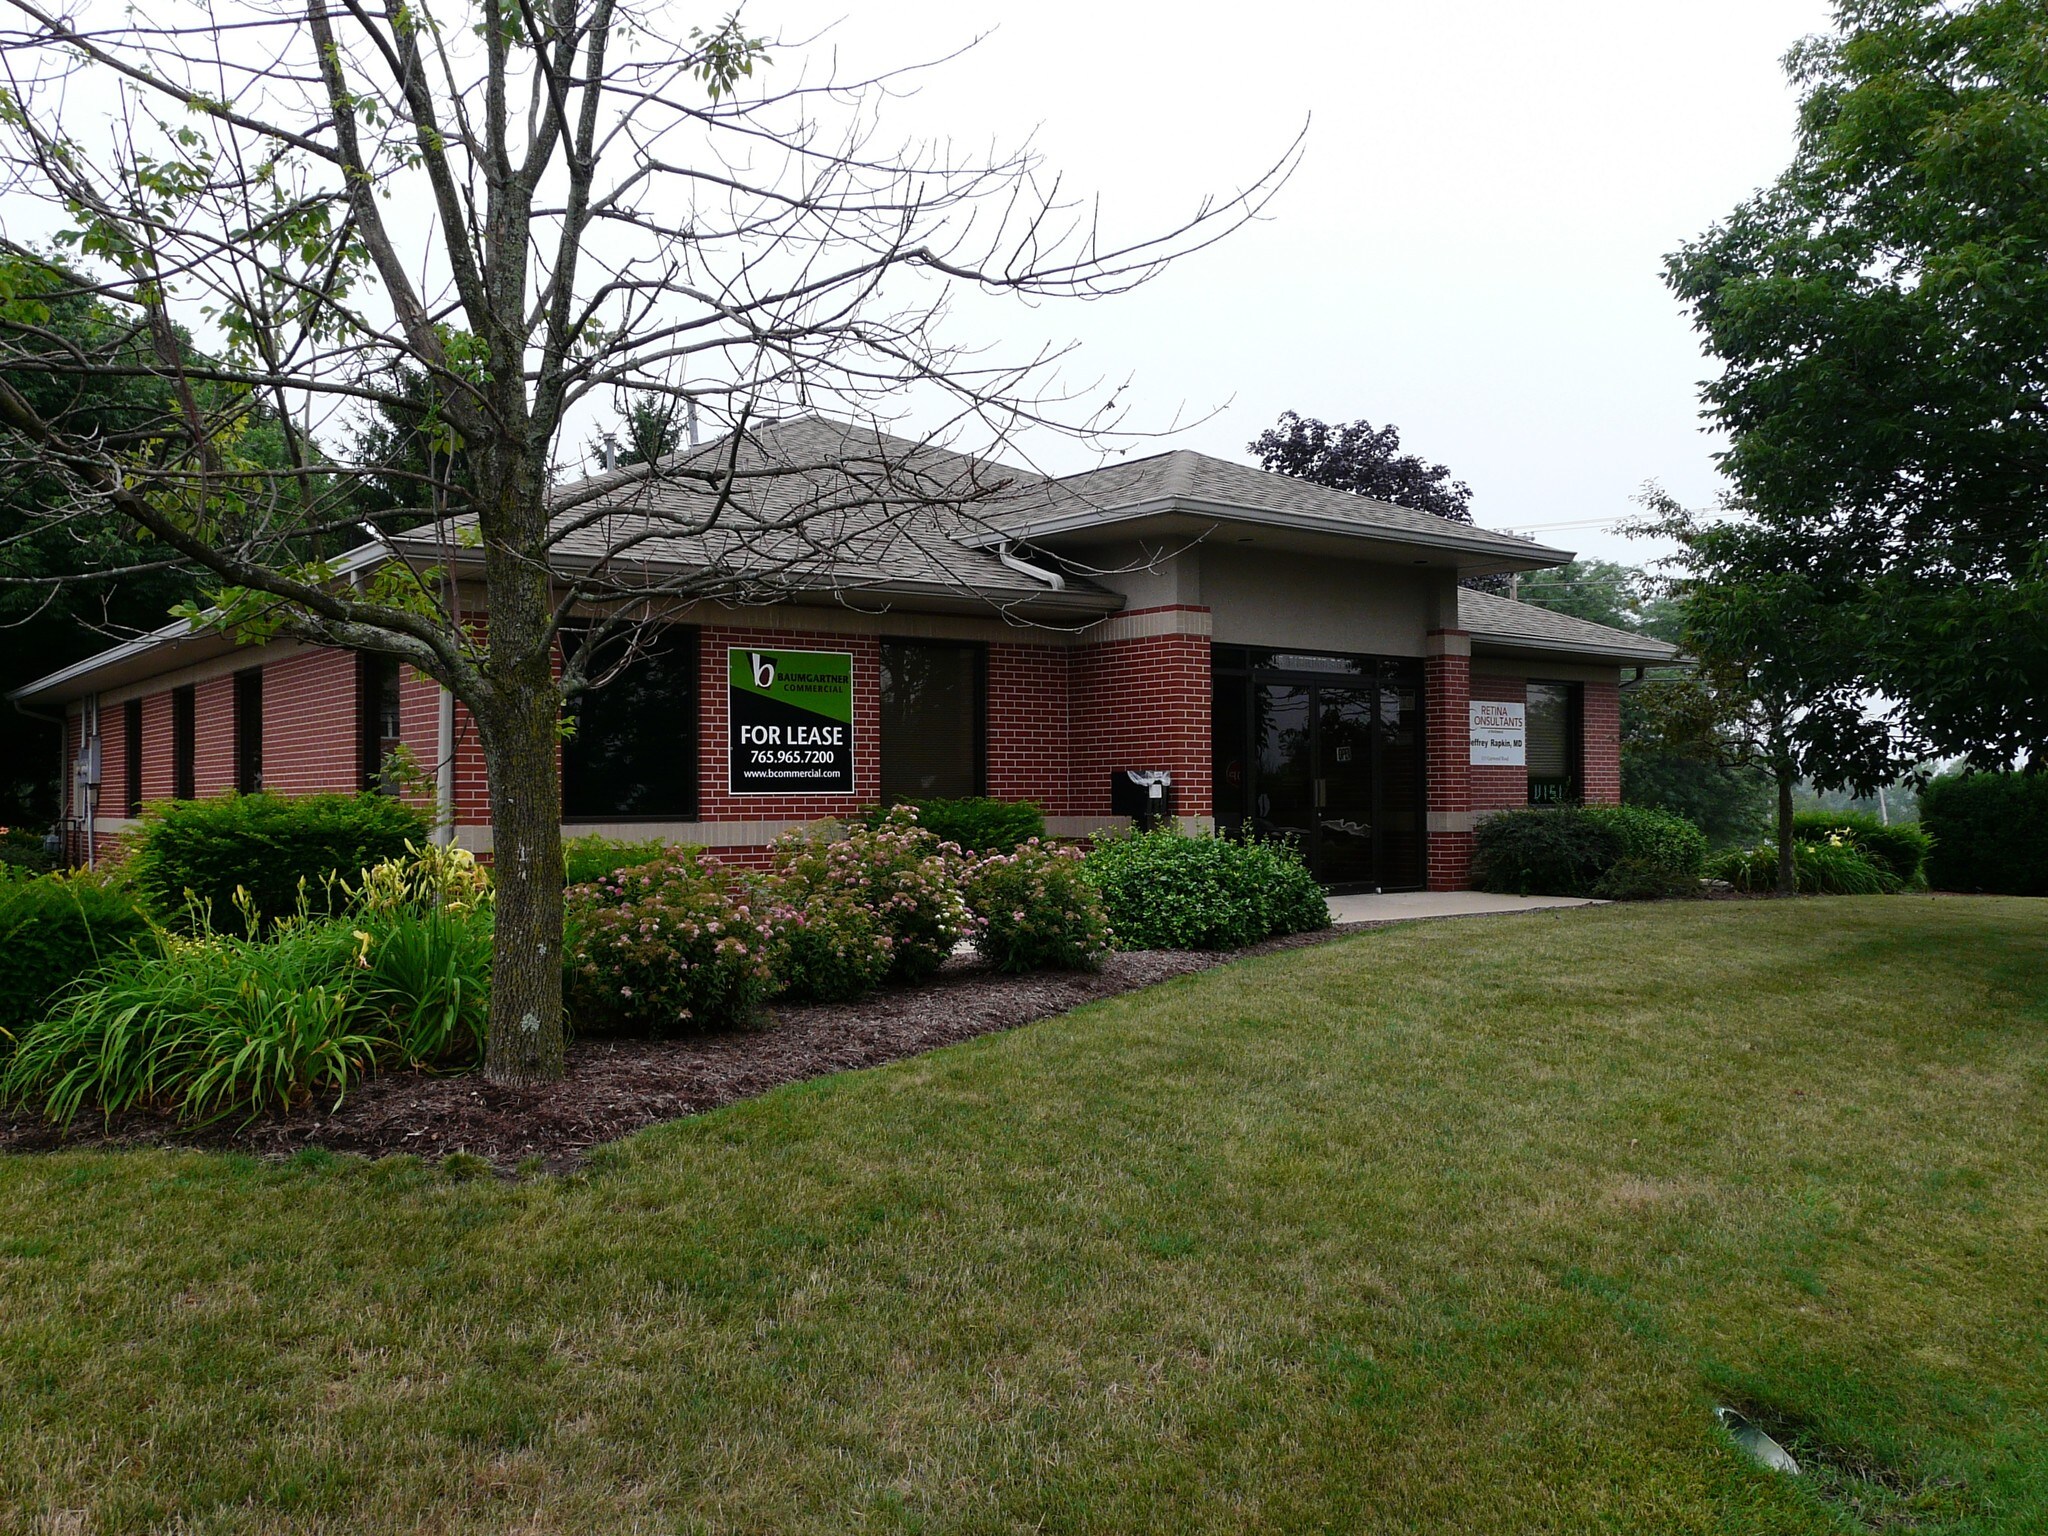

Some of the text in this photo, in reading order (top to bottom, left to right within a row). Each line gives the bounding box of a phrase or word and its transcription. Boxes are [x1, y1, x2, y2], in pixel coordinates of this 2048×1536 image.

[777, 673, 848, 684] BAUMGARTNER
[783, 683, 844, 694] COMMERCIAL
[1481, 706, 1507, 716] RETINA
[741, 725, 843, 745] FOR LEASE
[1470, 738, 1523, 749] effrey Rapkin, MD
[750, 750, 834, 764] 765.965.7200
[743, 768, 841, 779] www.bcommercial.com
